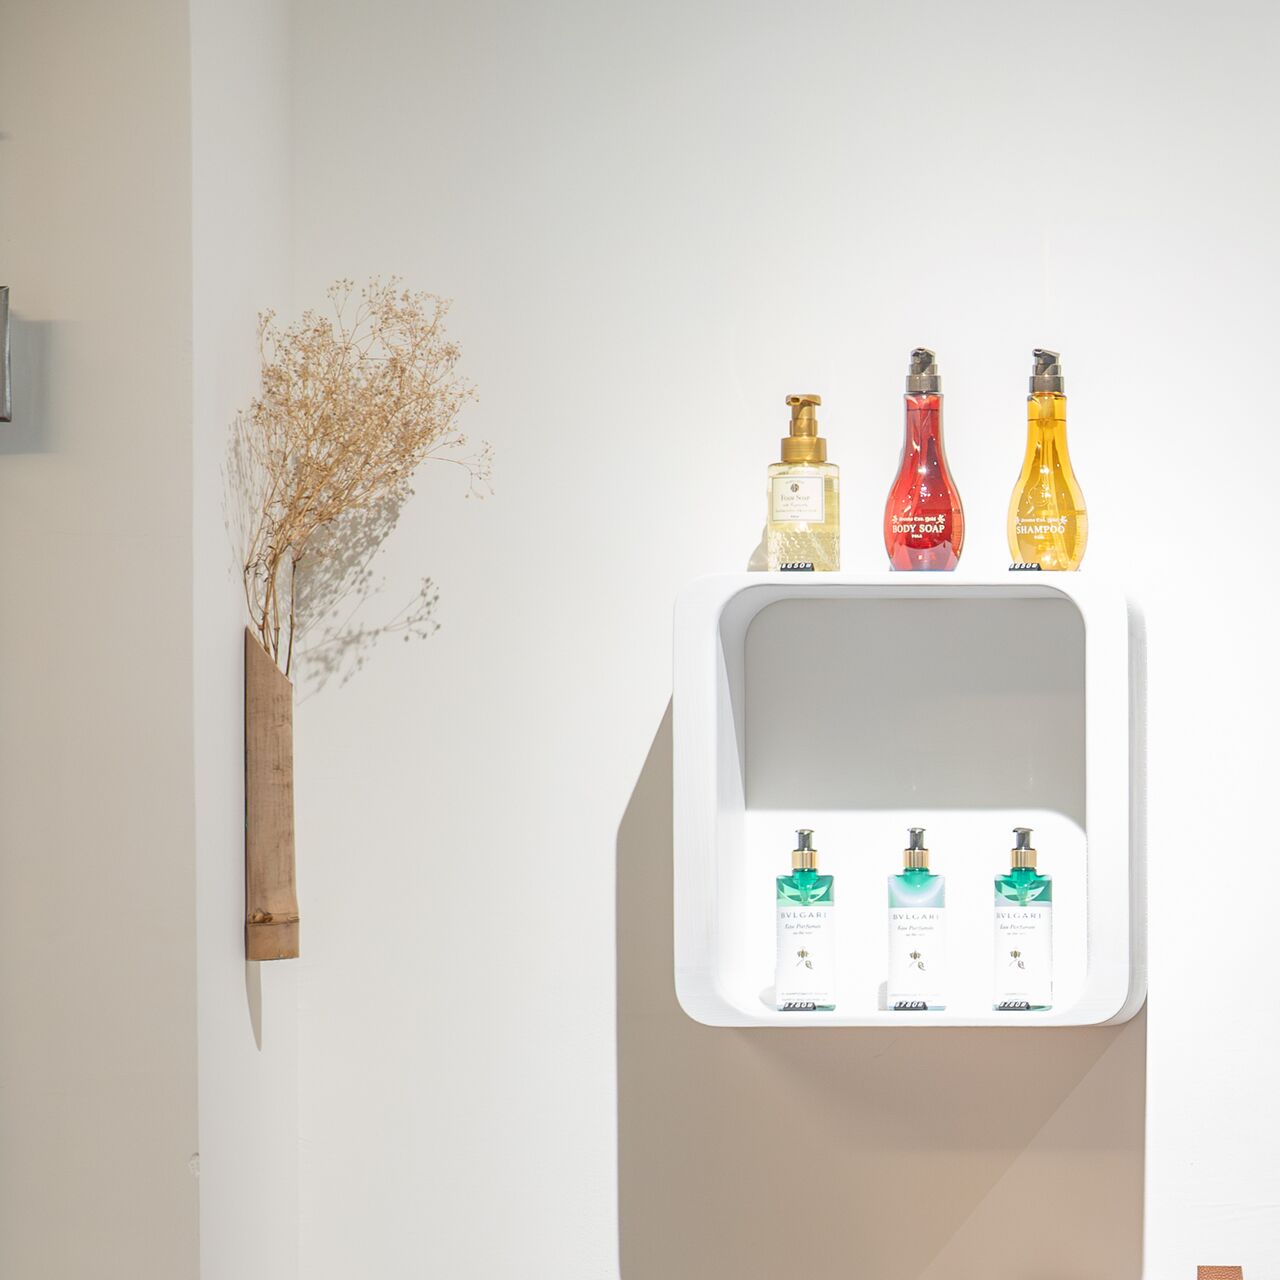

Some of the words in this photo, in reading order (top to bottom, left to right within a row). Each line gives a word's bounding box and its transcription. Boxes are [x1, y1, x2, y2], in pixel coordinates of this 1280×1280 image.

[892, 524, 916, 533] BODY
[919, 524, 945, 533] SOAP
[1016, 525, 1065, 534] SHAMPOO
